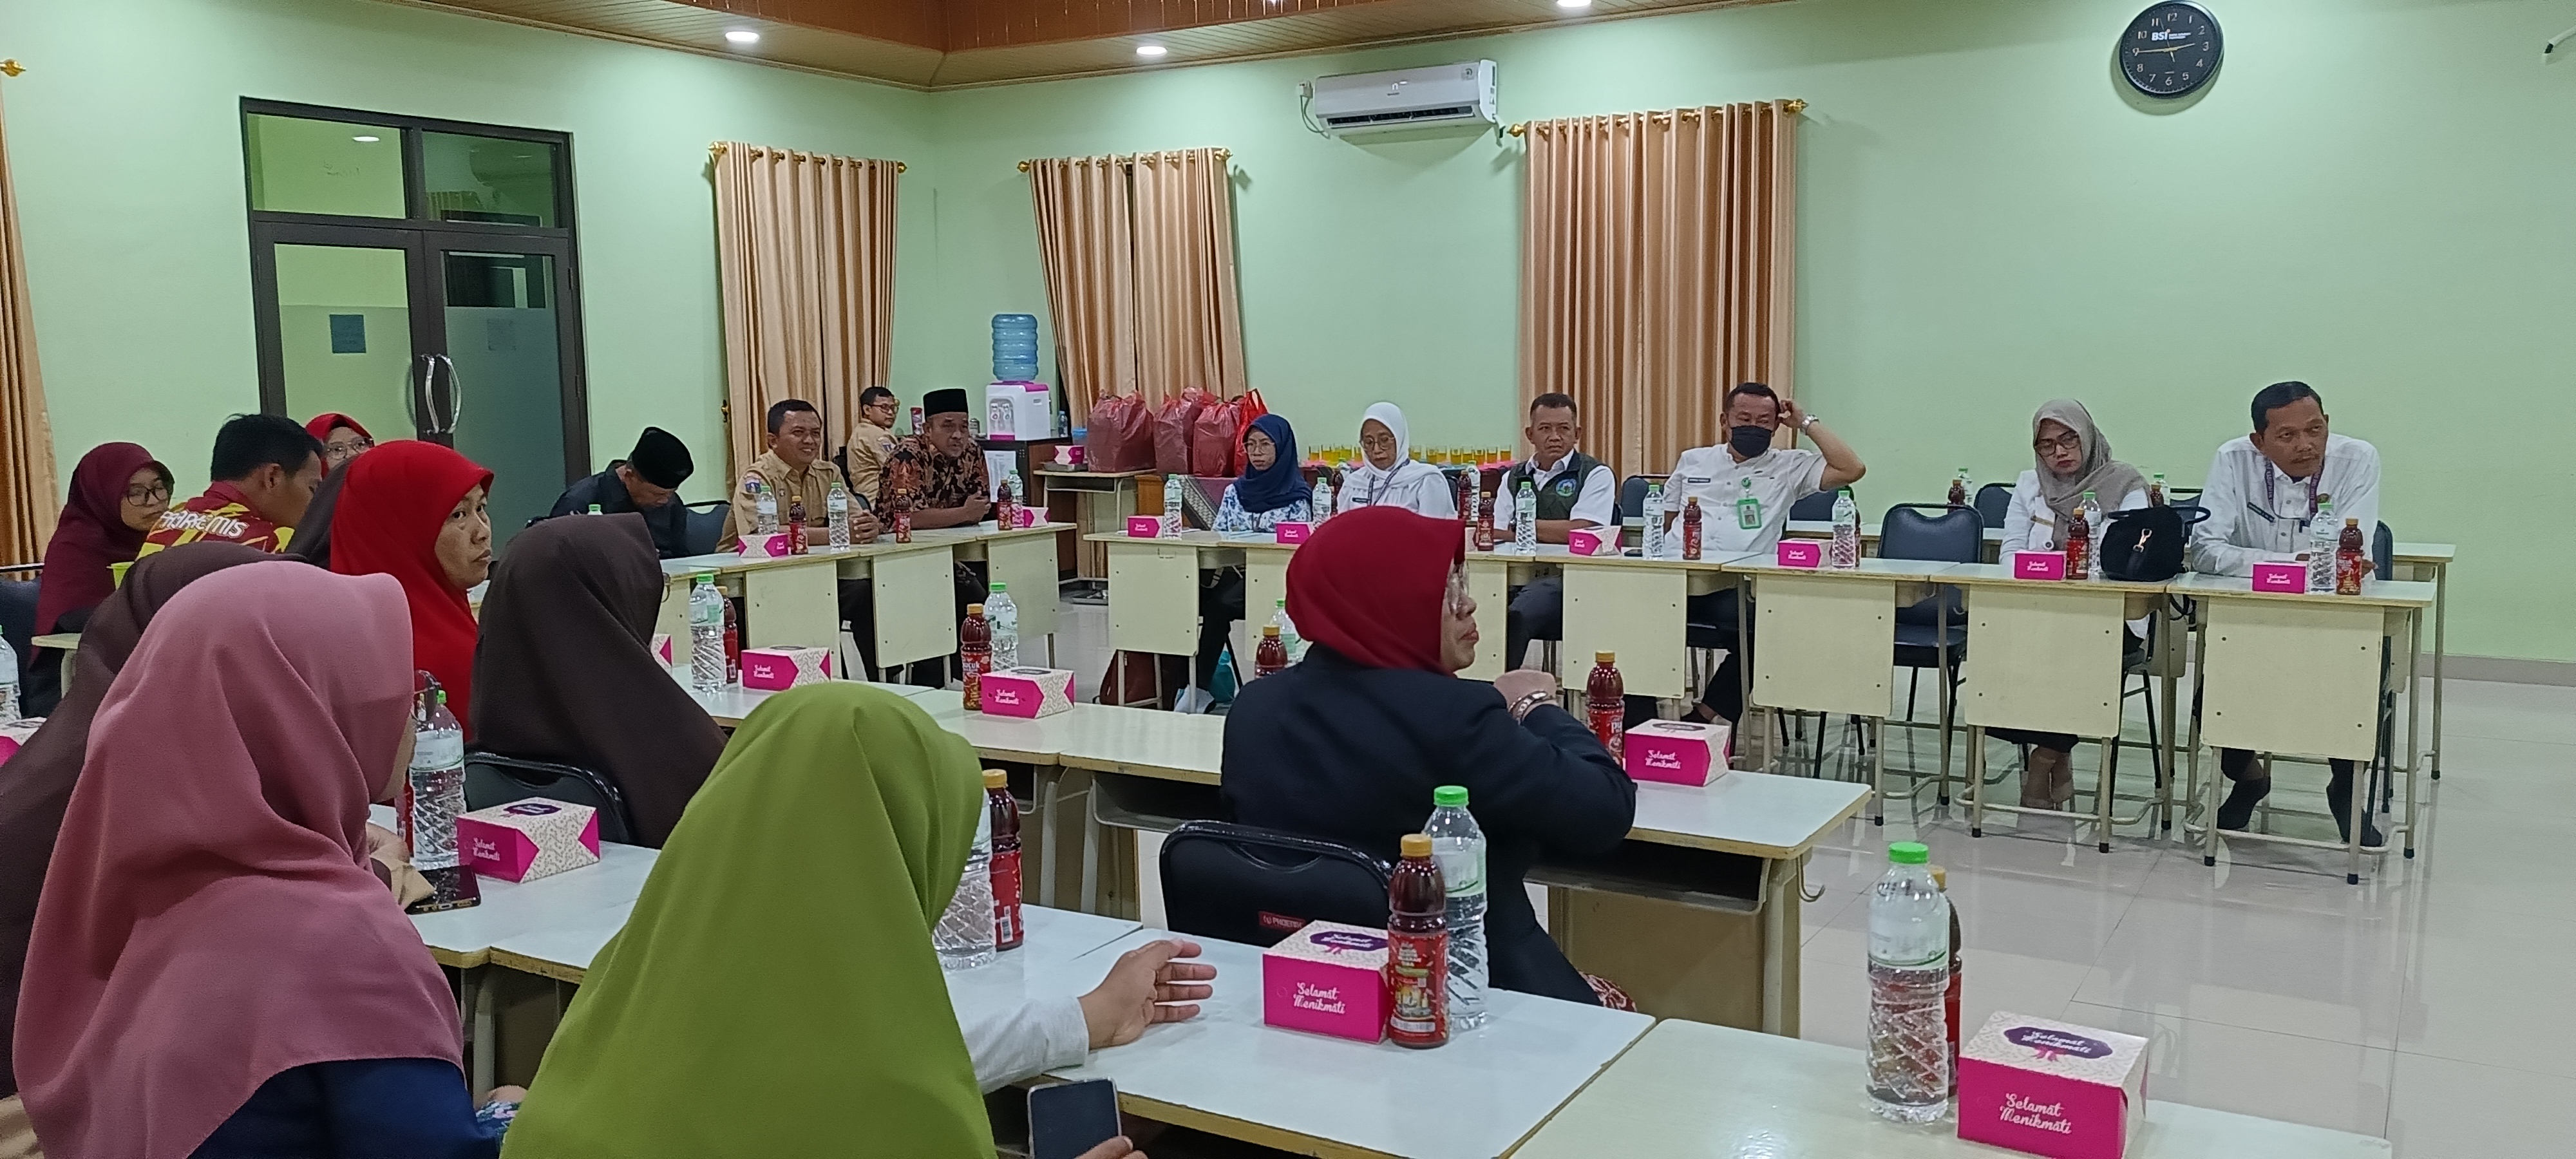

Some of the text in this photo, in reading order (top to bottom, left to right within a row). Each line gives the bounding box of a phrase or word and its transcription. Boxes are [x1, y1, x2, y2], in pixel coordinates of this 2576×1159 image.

[2152, 18, 2159, 26] 11
[2167, 12, 2177, 22] 12
[2137, 30, 2147, 39] 10
[2152, 29, 2170, 41] BSI
[2198, 25, 2205, 35] 2
[2132, 47, 2140, 56] 9
[2202, 41, 2210, 52] 3
[2137, 63, 2144, 73] 8
[2195, 58, 2203, 68] 4
[2148, 73, 2156, 83] 7
[2182, 72, 2189, 80] 5
[2165, 77, 2172, 86] 6
[1296, 982, 1340, 1001] Selamat
[1293, 994, 1345, 1014] Menikmati
[2005, 1093, 2065, 1117] Selamat
[1999, 1105, 2072, 1135] Menikmati
